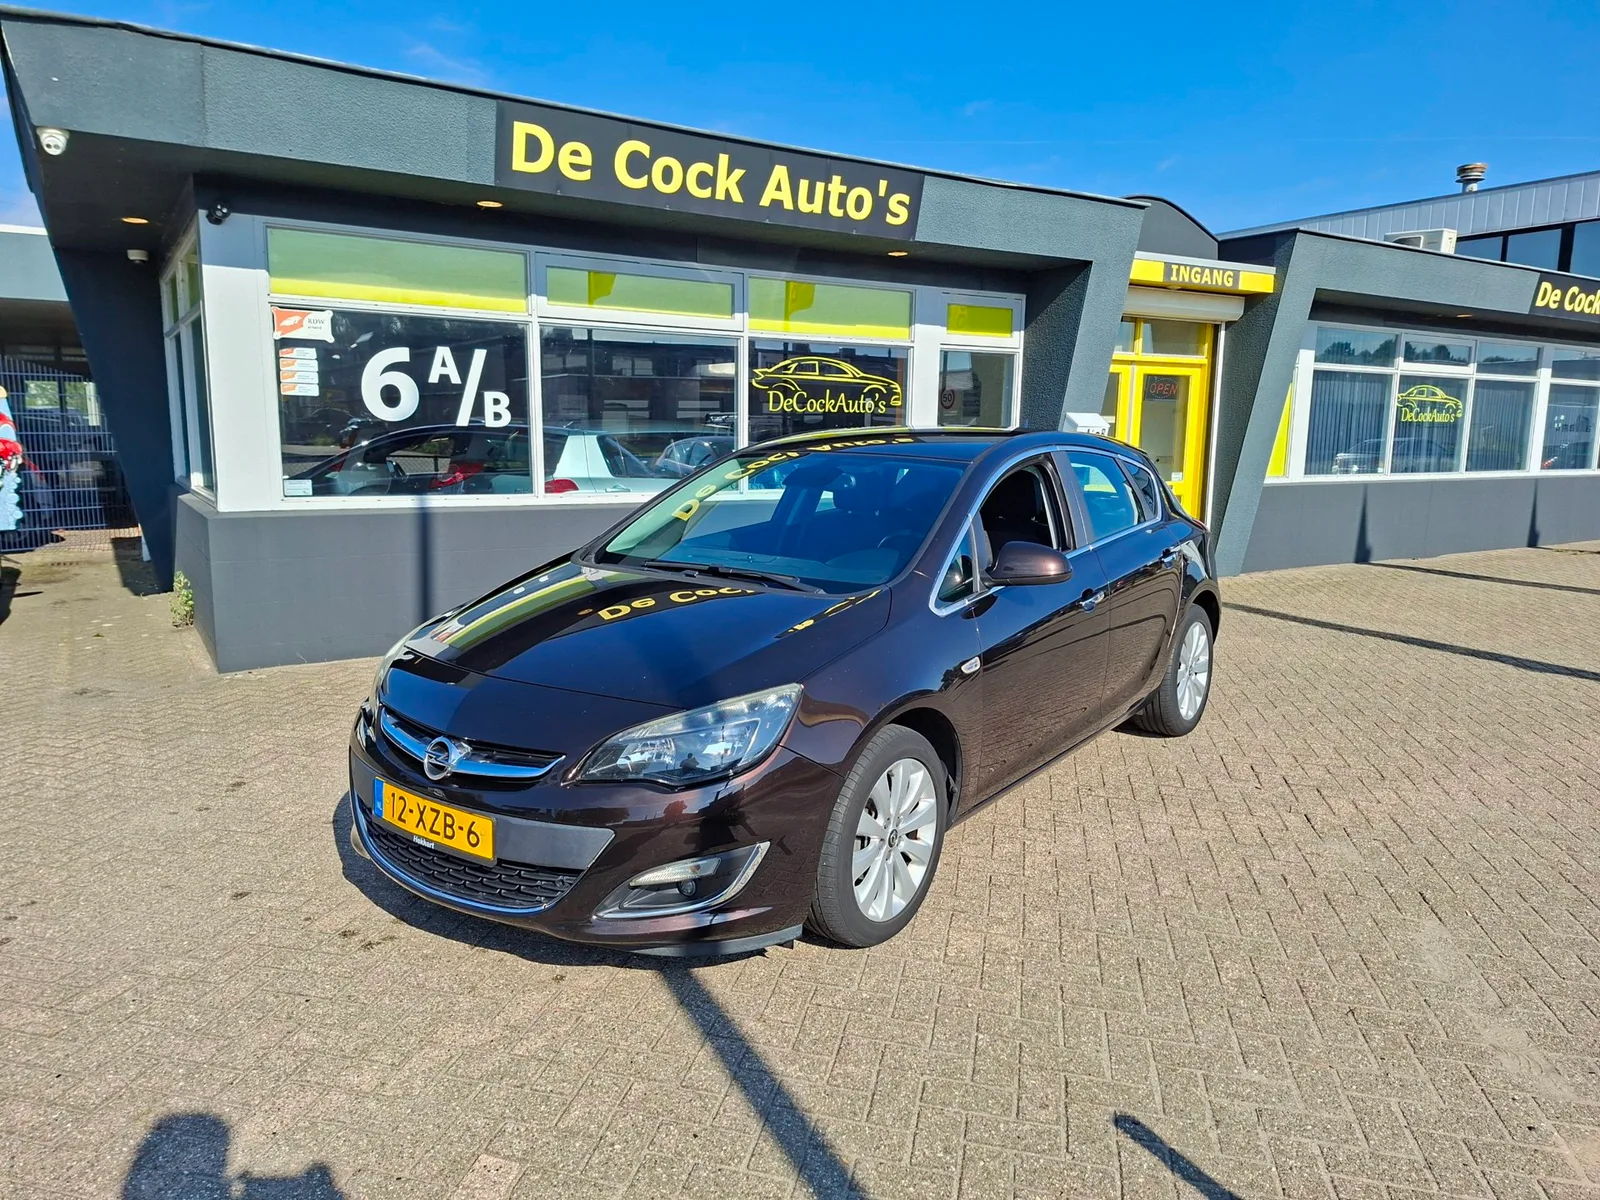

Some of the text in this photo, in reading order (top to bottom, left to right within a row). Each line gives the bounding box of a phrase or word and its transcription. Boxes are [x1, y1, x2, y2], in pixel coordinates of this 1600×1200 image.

[511, 120, 911, 226] De Cock Auto's
[1170, 264, 1234, 287] INGANG
[1535, 281, 1562, 309] De
[942, 393, 953, 403] 50
[1150, 382, 1178, 395] OPEN
[767, 388, 887, 414] DeCockAuto's
[1401, 406, 1455, 422] DeCockAuto's
[391, 792, 480, 848] 12-XZB-6
